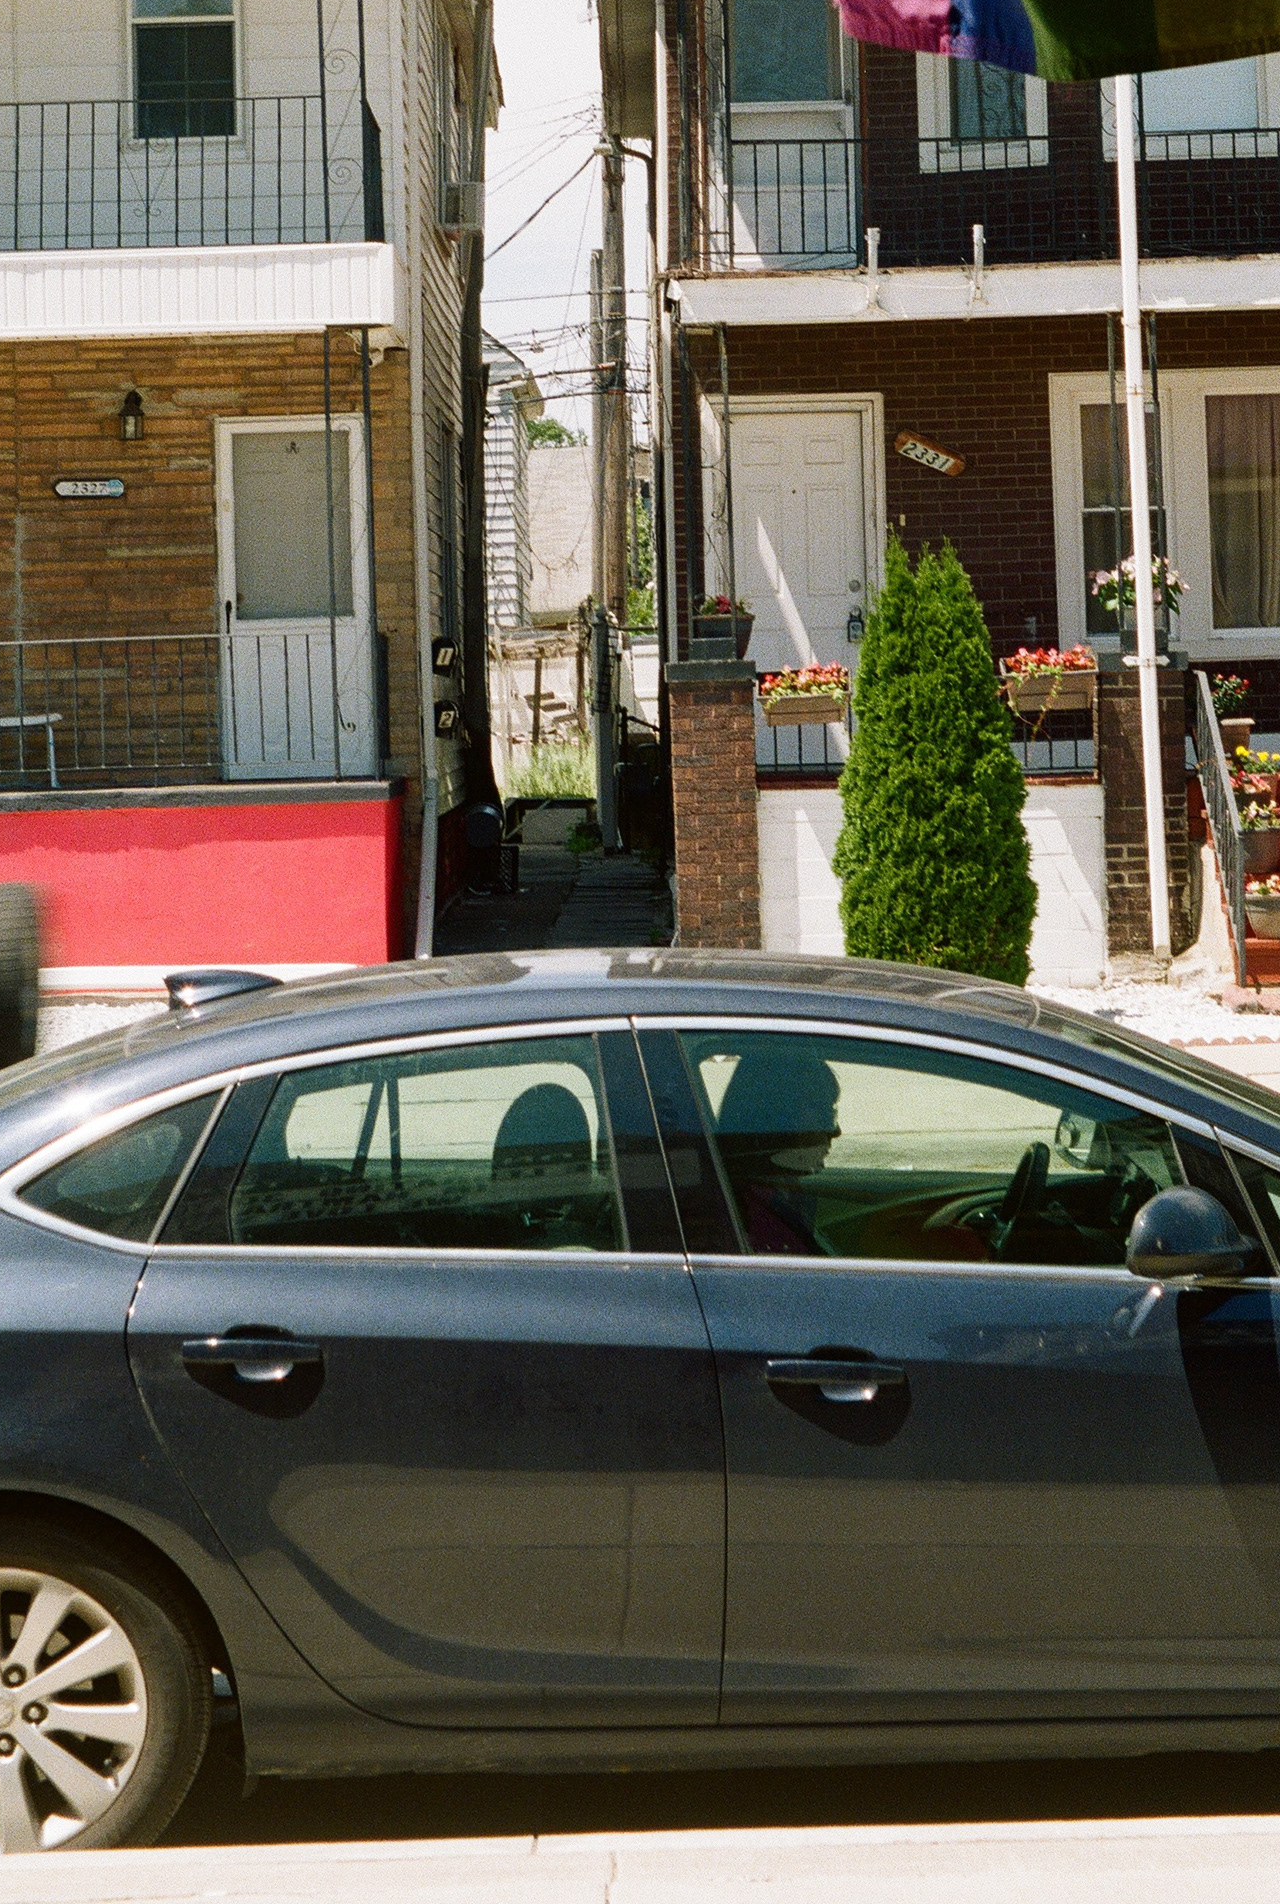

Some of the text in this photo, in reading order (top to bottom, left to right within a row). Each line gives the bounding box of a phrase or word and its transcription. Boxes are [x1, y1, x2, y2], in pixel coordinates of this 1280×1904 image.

[902, 442, 951, 469] 2331
[71, 482, 107, 495] 2327
[441, 712, 452, 726] 2
